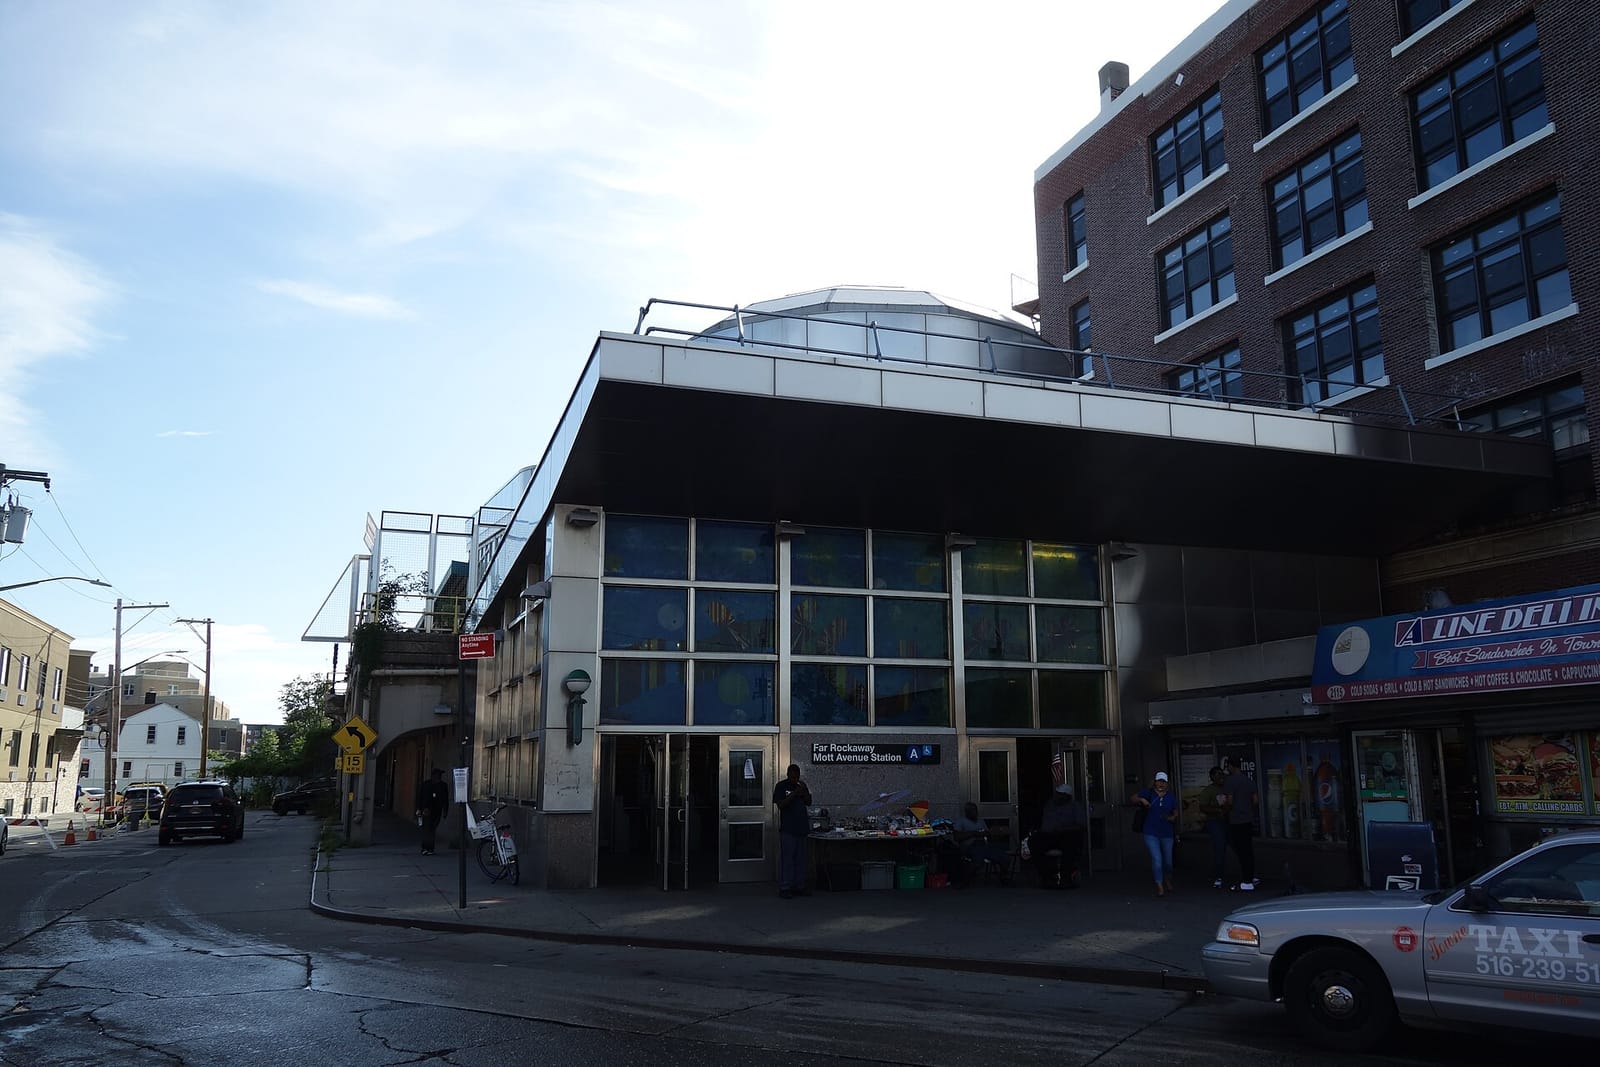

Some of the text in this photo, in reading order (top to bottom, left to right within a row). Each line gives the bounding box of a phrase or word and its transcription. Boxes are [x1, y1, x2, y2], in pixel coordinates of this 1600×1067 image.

[1397, 616, 1424, 647] A
[1432, 611, 1497, 640] LINE
[1501, 600, 1573, 631] DELI
[1433, 650, 1462, 666] Best
[1464, 643, 1534, 663] Sandwiches
[1539, 638, 1558, 655] In
[1350, 685, 1363, 697] COLD
[1363, 683, 1379, 696] SODAS
[1384, 682, 1399, 694] GRILL
[1404, 681, 1418, 693] COLD
[1423, 679, 1434, 691] HOT
[1434, 675, 1470, 690] SANDWICHES
[1474, 674, 1487, 687] HOT
[1487, 672, 1509, 686] COFFEE
[1510, 671, 1515, 684] &
[1516, 668, 1553, 684] CHOCOLATE
[813, 743, 875, 754] Far Rockaway
[813, 752, 902, 762] Mott Avenue Station
[910, 747, 919, 759] A
[347, 756, 360, 766] 15
[1533, 802, 1560, 812] CALLING
[1560, 802, 1585, 812] CARDS
[1468, 924, 1585, 960] TAXI
[1476, 954, 1600, 985] 516-239-51
